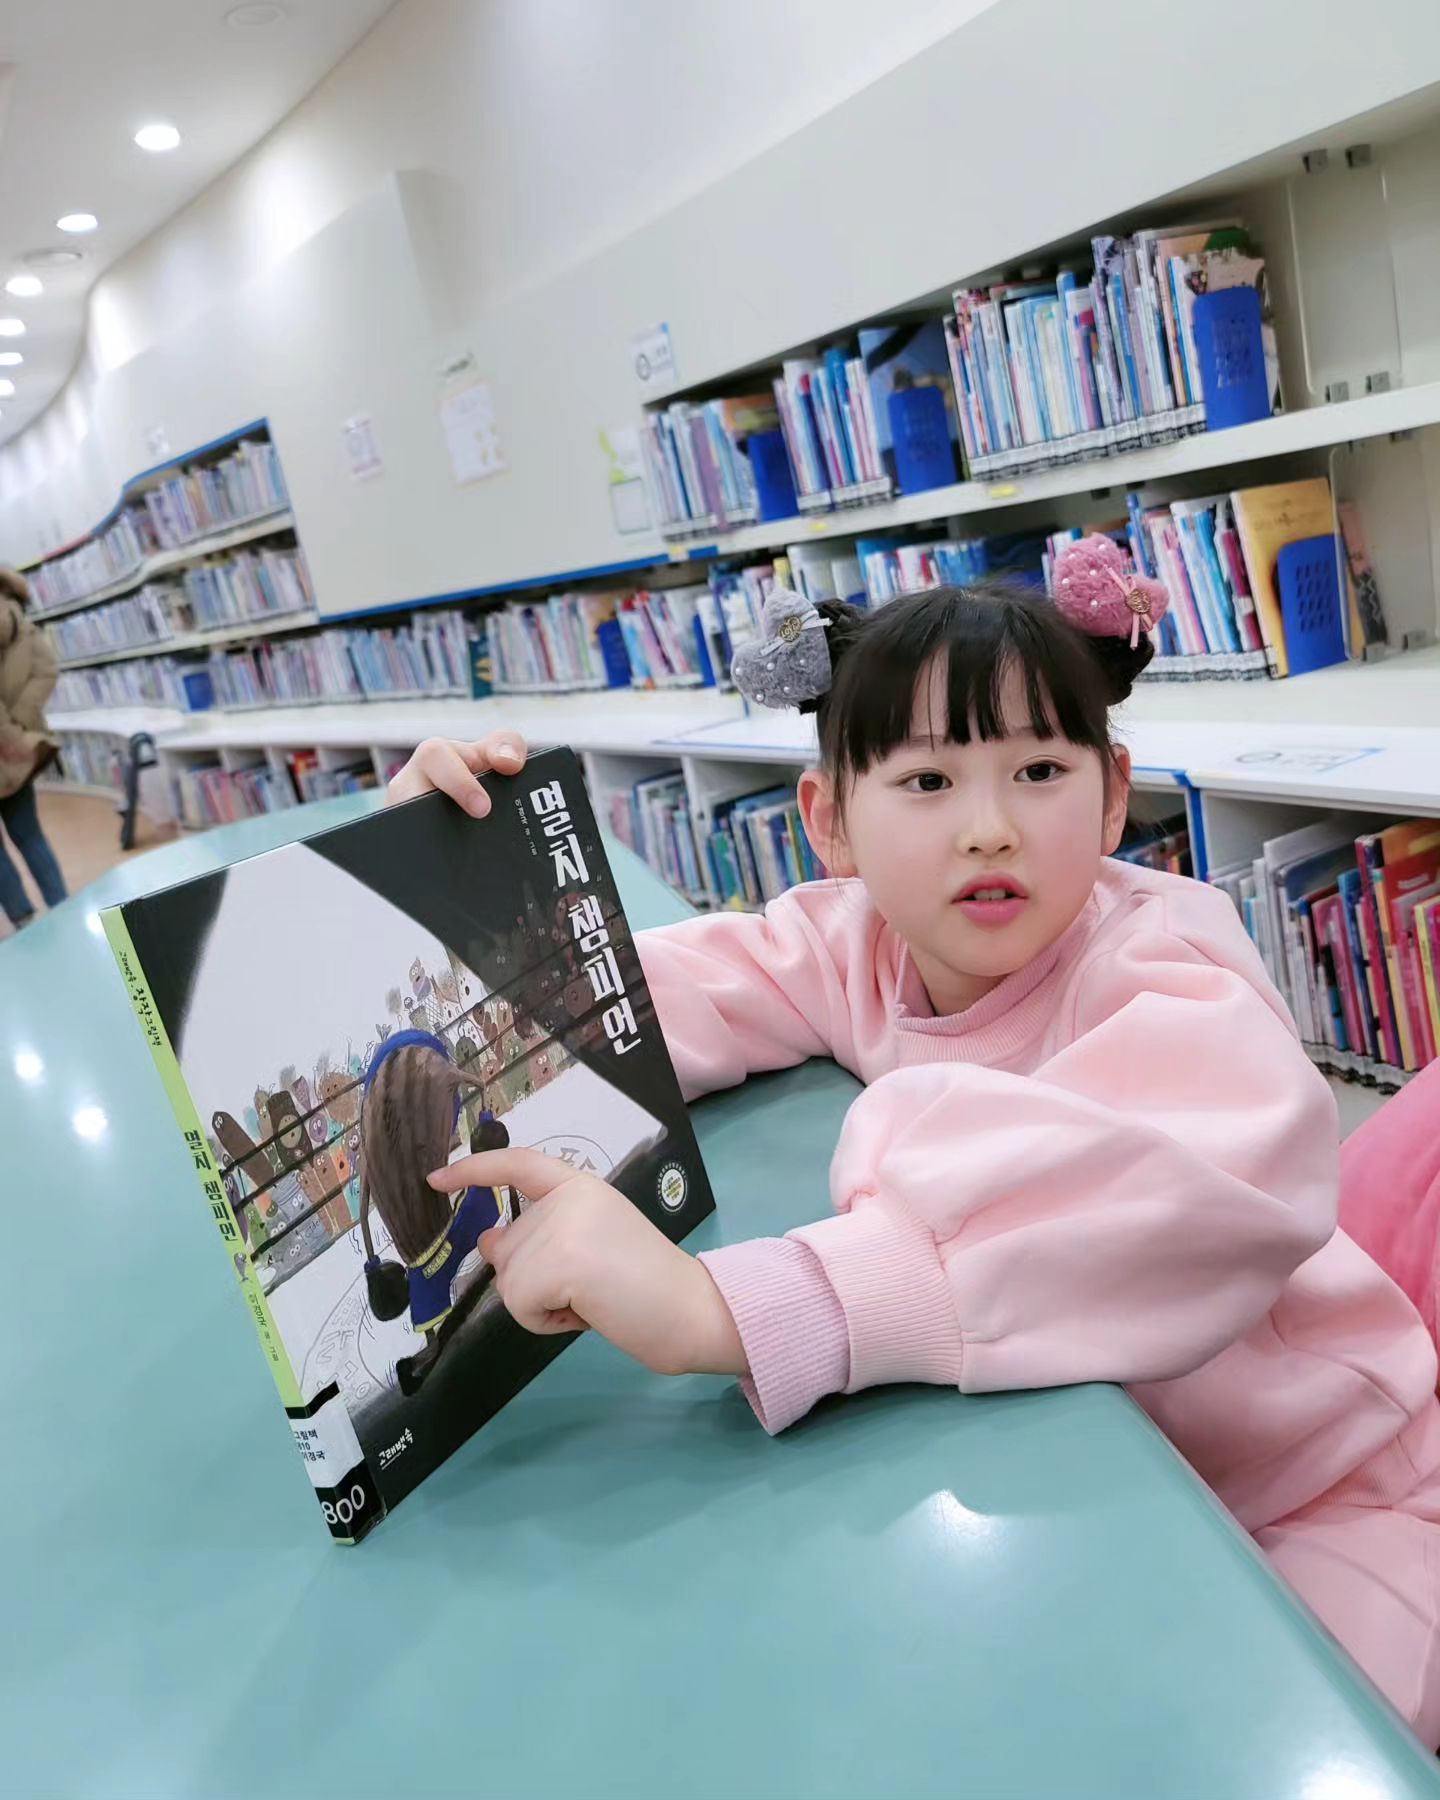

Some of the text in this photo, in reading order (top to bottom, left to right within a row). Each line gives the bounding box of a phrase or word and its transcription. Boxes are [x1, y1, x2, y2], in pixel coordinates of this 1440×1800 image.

[529, 780, 642, 1055] 멸치 챔피언
[132, 987, 162, 1046] 창작그림책
[184, 1129, 238, 1242] 멸치 챔피언
[293, 1428, 318, 1440] 그림책
[377, 1427, 414, 1466] 고래뱃속
[321, 1484, 365, 1525] 800
